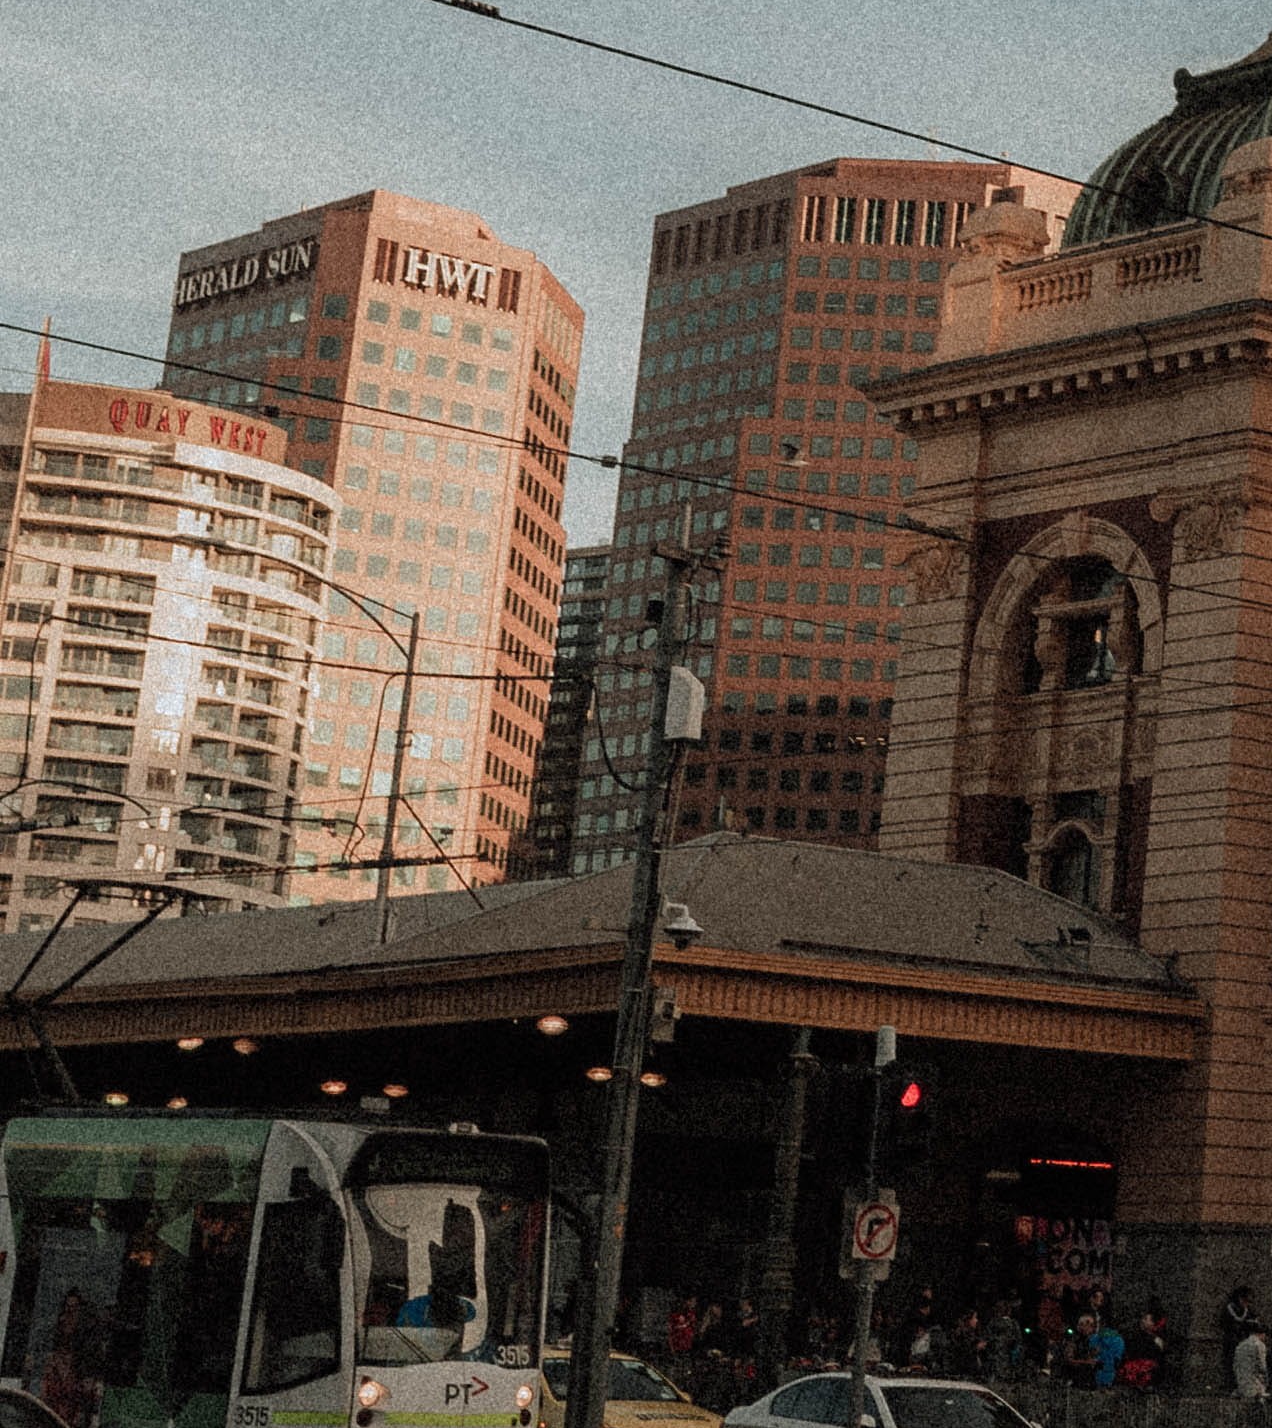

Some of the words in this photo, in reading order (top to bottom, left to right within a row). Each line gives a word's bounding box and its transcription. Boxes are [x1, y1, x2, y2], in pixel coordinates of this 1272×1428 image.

[173, 257, 260, 305] HERALD
[264, 240, 314, 279] SUN
[404, 247, 496, 299] HWT
[109, 398, 192, 436] QUAY
[209, 415, 268, 457] WEST
[496, 1343, 531, 1367] 3515
[234, 1405, 269, 1427] 3515
